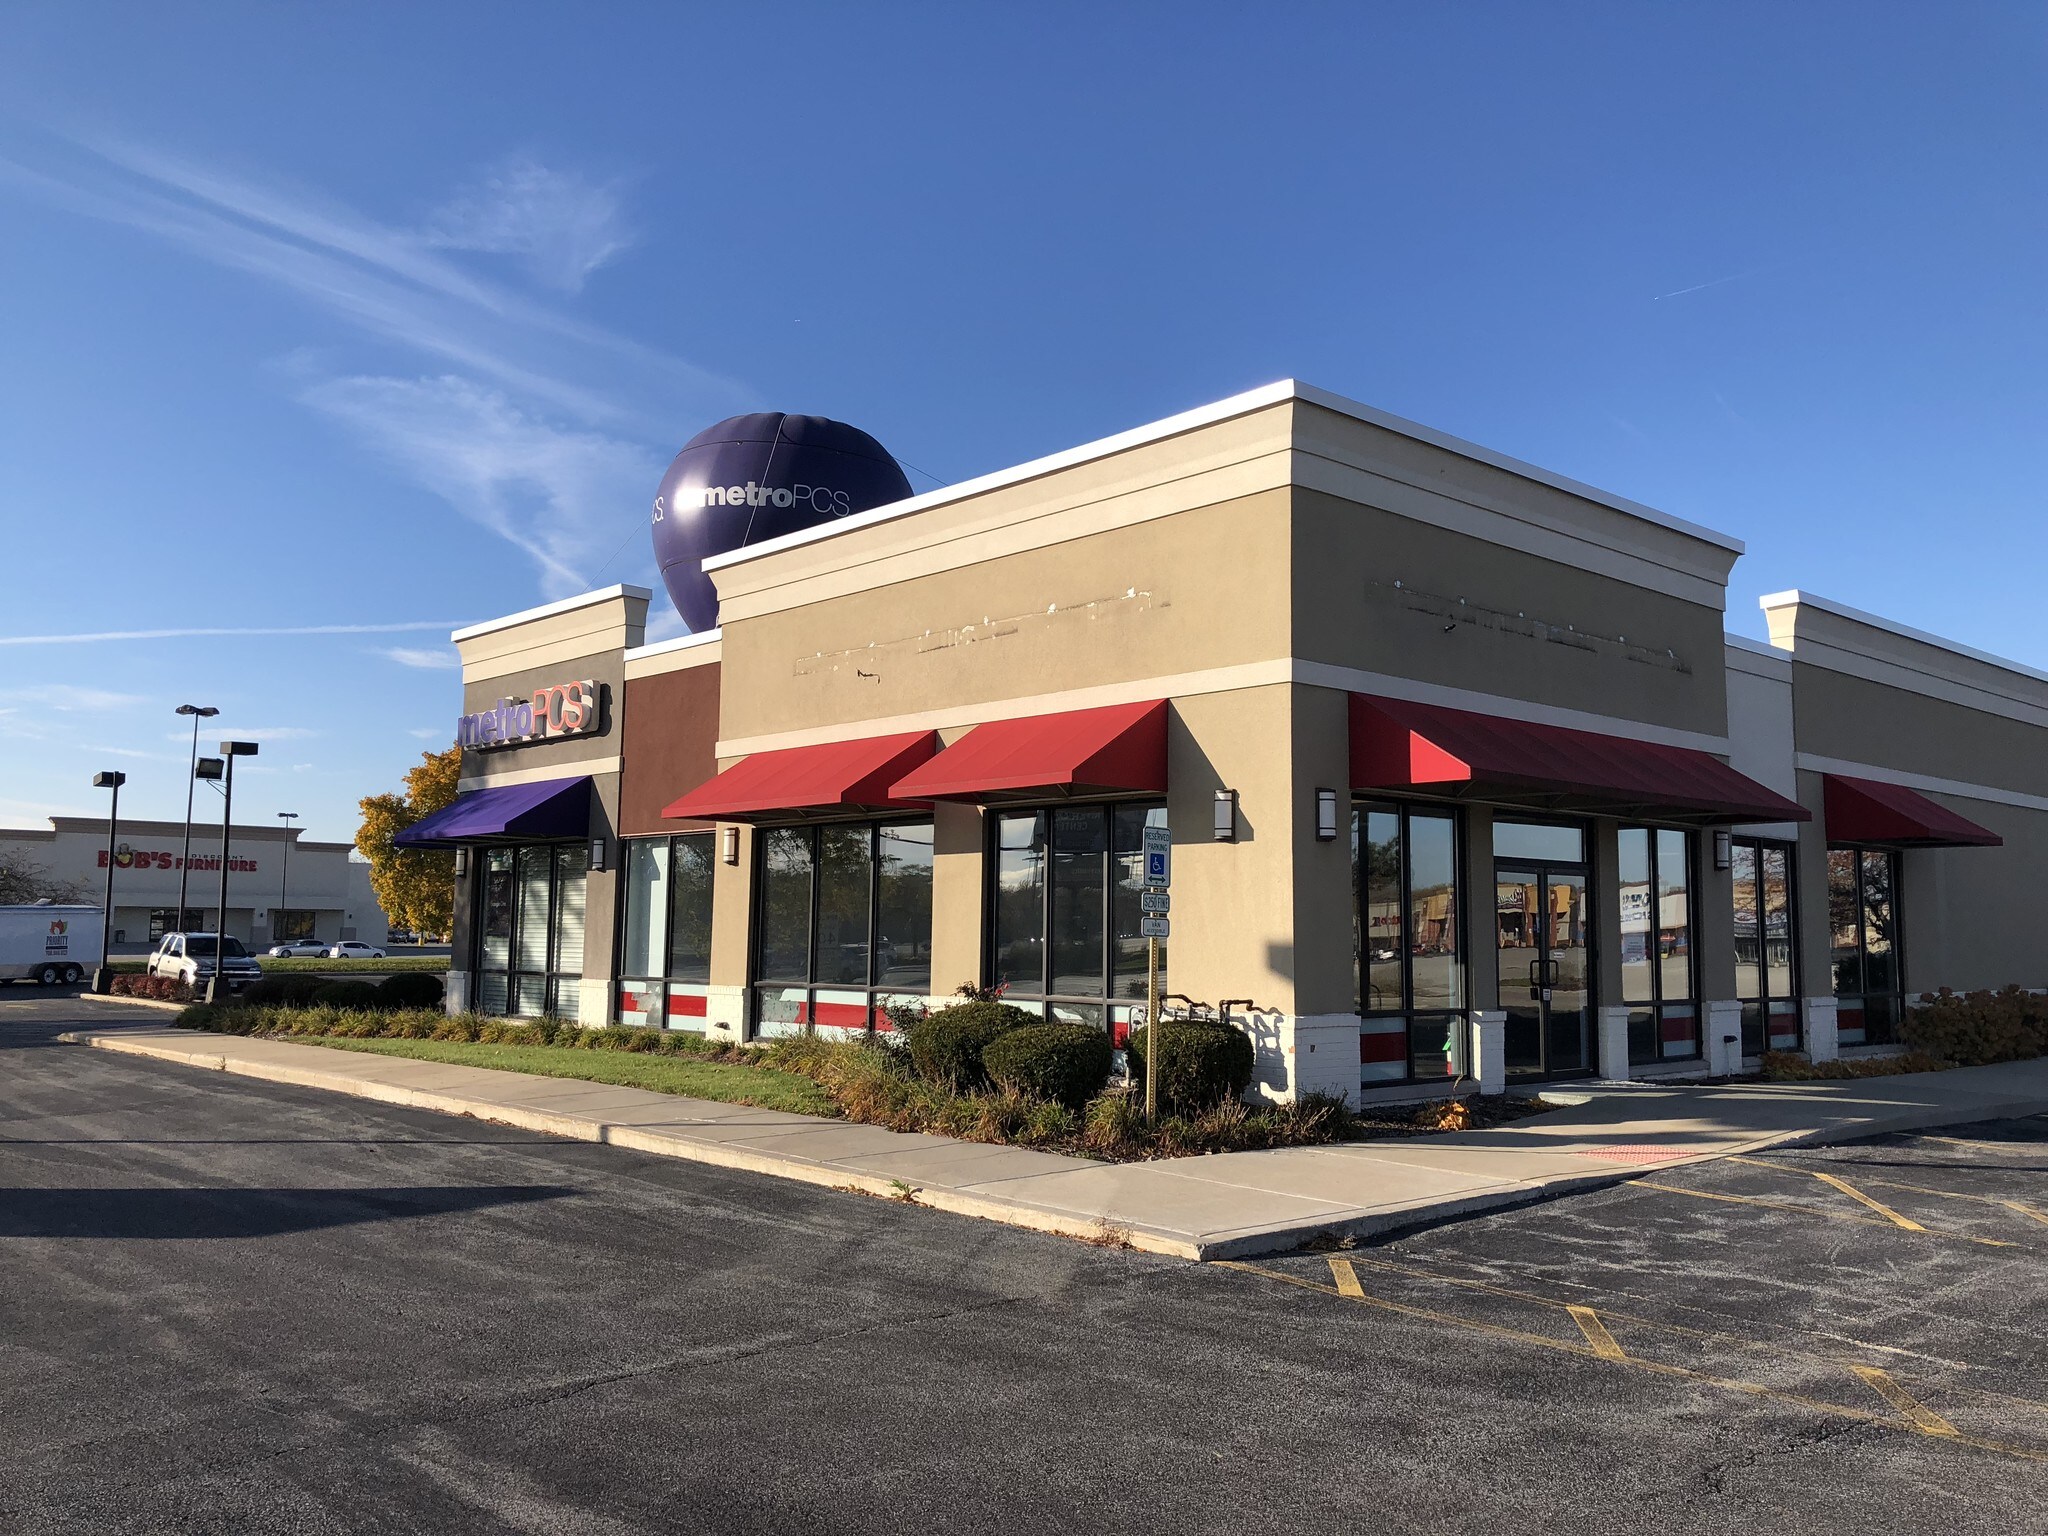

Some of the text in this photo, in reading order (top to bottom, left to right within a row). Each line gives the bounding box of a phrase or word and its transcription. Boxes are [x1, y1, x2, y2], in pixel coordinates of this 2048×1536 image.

[701, 481, 850, 517] metroPCS
[458, 681, 584, 747] metroPCS
[1146, 832, 1170, 842] RESERVED
[1147, 843, 1167, 851] PARKING
[97, 850, 257, 872] BOB'S FURNIURE
[1144, 896, 1169, 909] $250 FINE
[46, 935, 69, 945] PRIORITY
